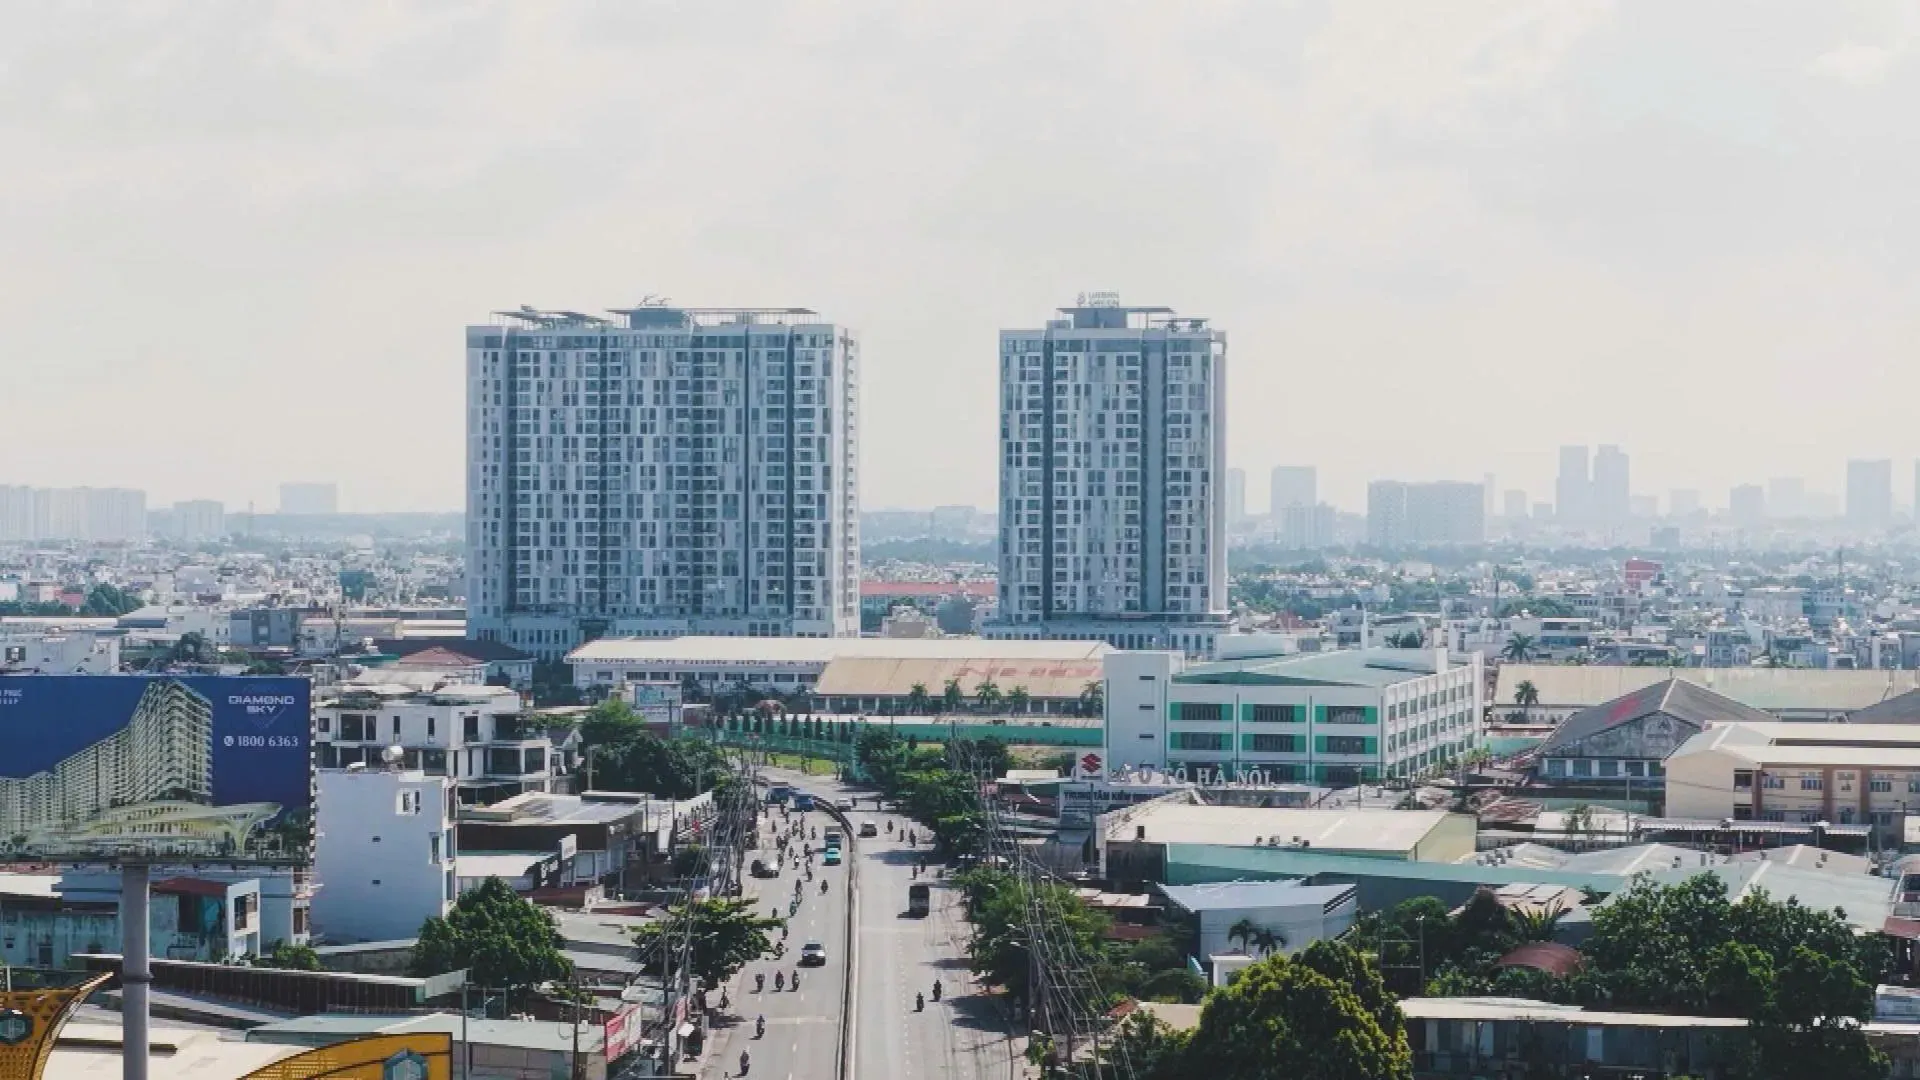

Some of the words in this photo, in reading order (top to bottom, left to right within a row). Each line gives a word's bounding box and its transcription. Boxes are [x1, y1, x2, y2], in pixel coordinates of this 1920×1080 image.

[228, 695, 295, 705] DIAMOND
[246, 705, 276, 714] SKY
[237, 735, 265, 747] 1800
[268, 735, 299, 747] 6363
[1196, 763, 1227, 787] HÀ
